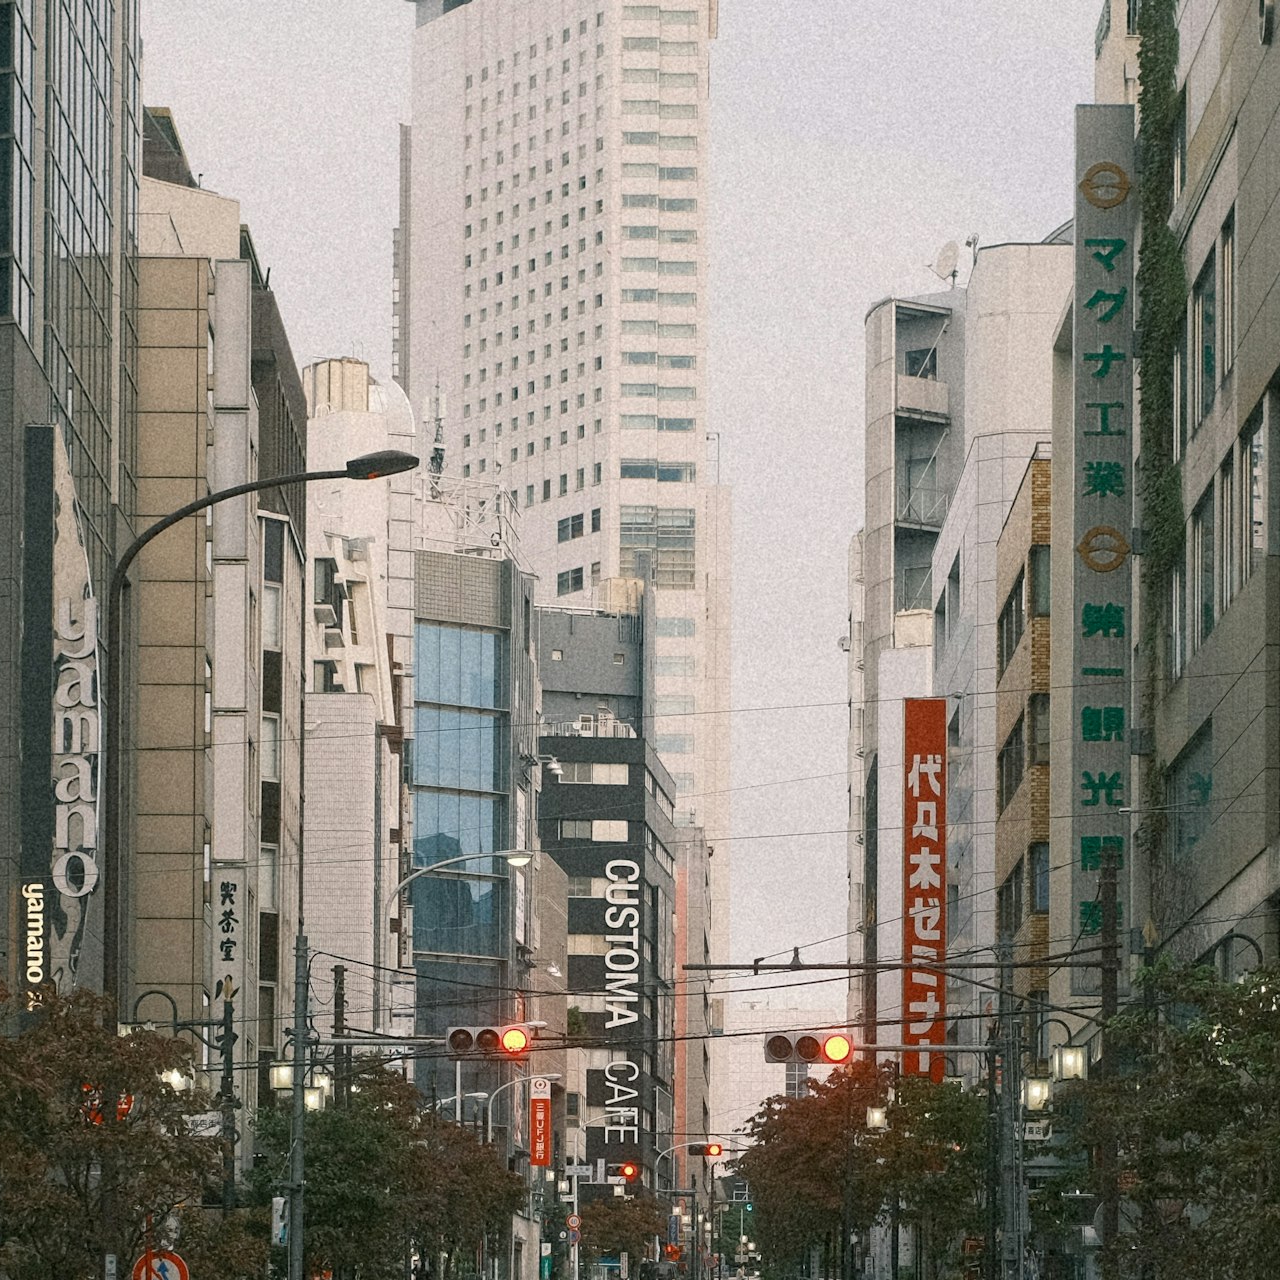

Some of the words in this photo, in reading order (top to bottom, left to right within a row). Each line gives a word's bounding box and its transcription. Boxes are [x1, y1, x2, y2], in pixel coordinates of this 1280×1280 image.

[1083, 237, 1129, 498] マグナ工業
[52, 596, 99, 899] yamano
[22, 883, 45, 984] yamano
[605, 858, 639, 1031] CUSTOMA
[907, 753, 944, 1074] 代々木ゼミナー
[604, 1060, 640, 1144] CAFE
